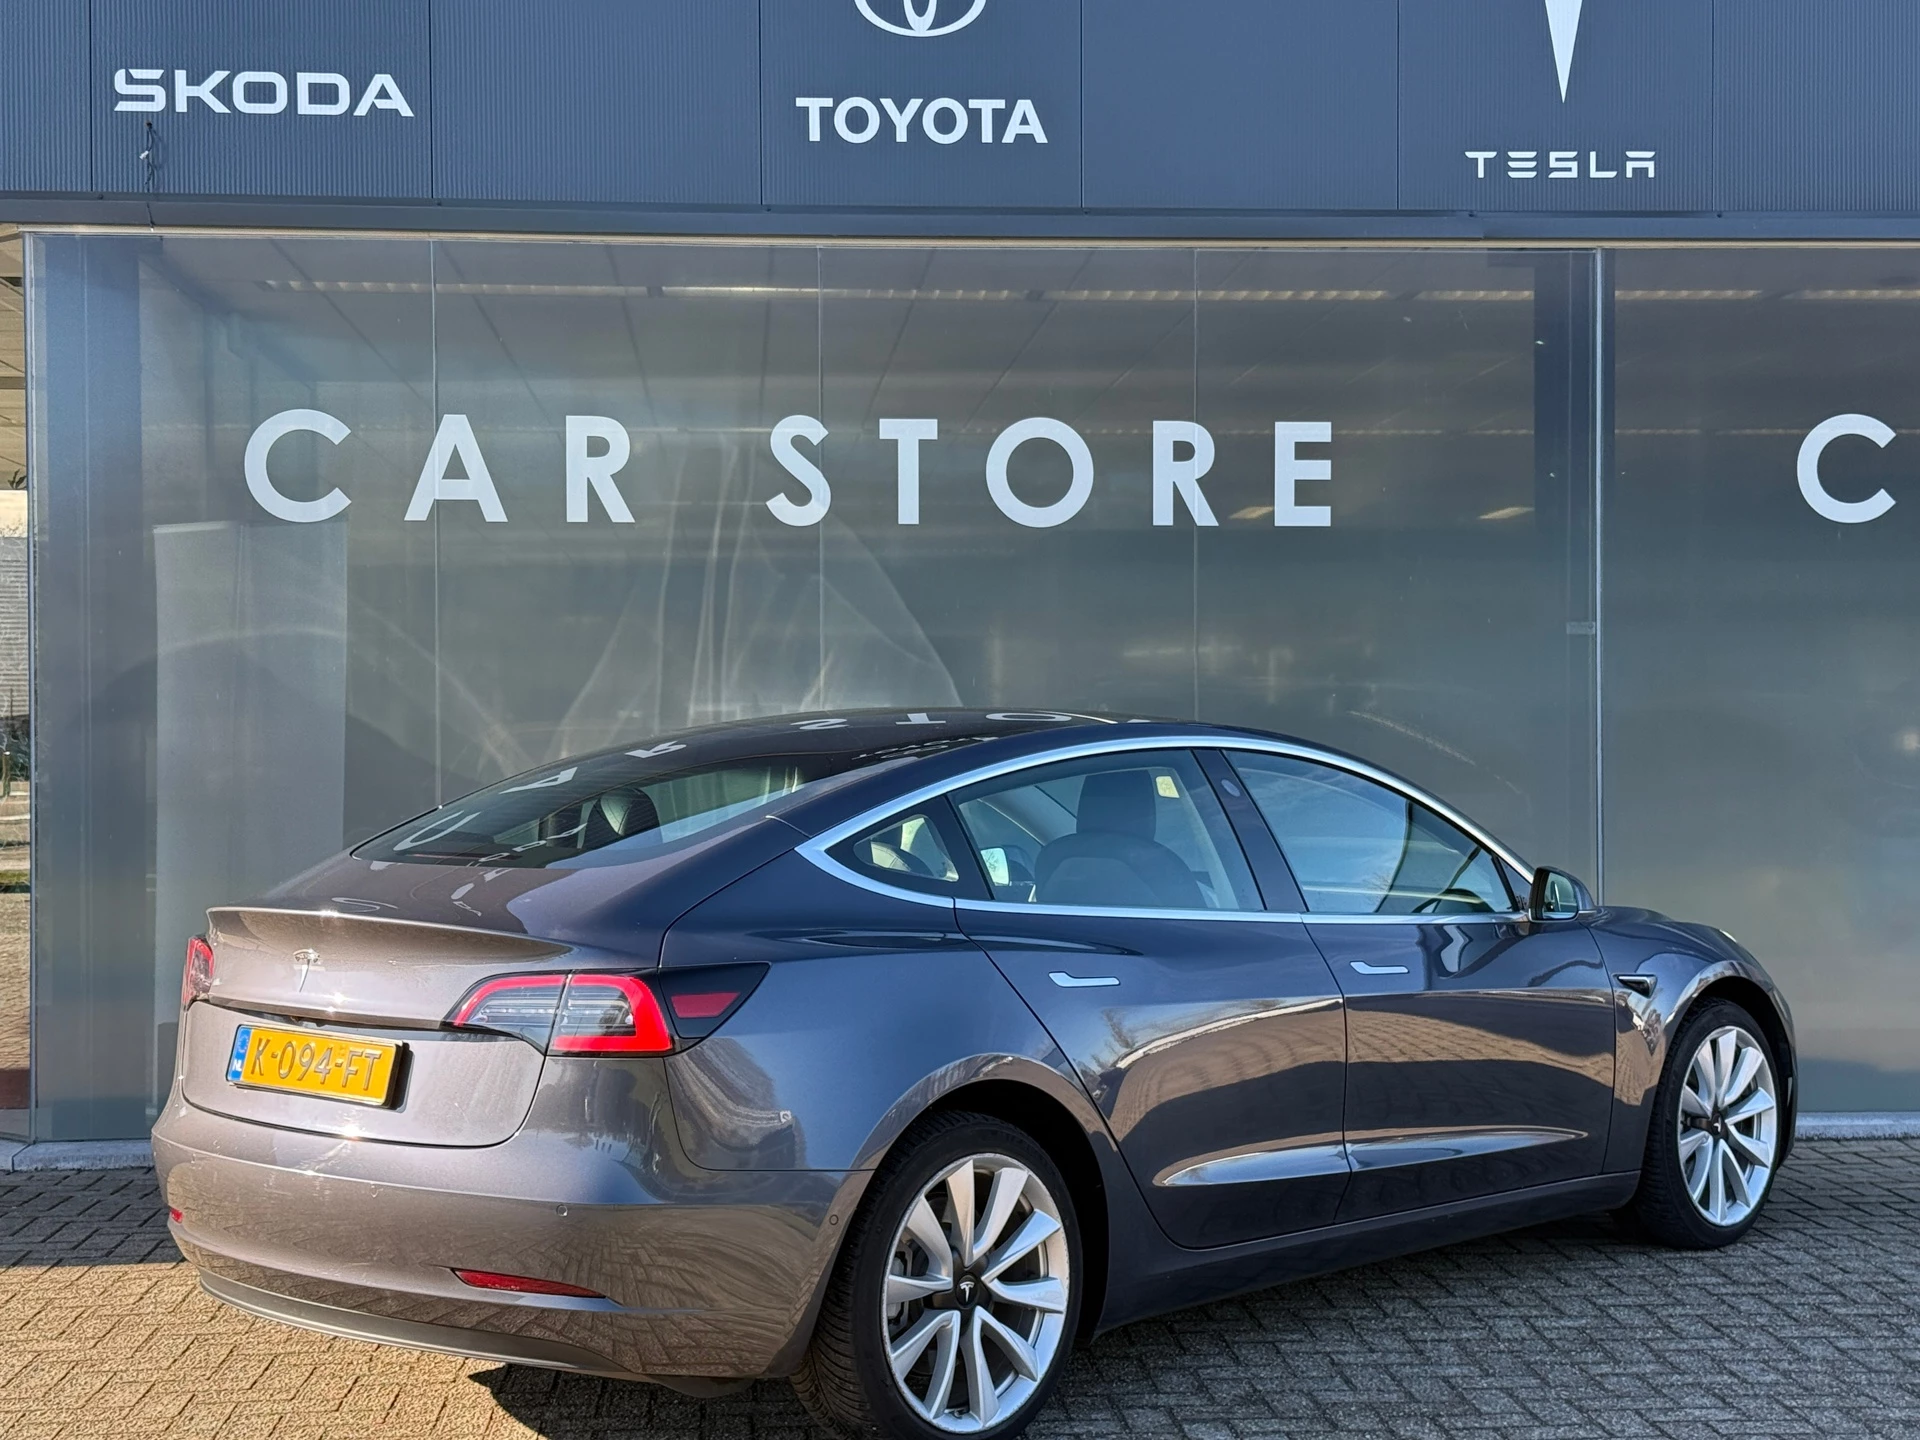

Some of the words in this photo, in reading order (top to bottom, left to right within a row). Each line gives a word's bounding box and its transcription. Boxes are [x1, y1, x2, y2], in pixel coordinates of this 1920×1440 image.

[796, 97, 1048, 145] TOYOTA
[1464, 151, 1656, 179] TESLA
[244, 408, 635, 523] CAR
[766, 414, 1332, 528] STORE
[1796, 413, 1897, 524] C
[232, 1058, 243, 1072] NL
[250, 1036, 383, 1091] K-094-FT
